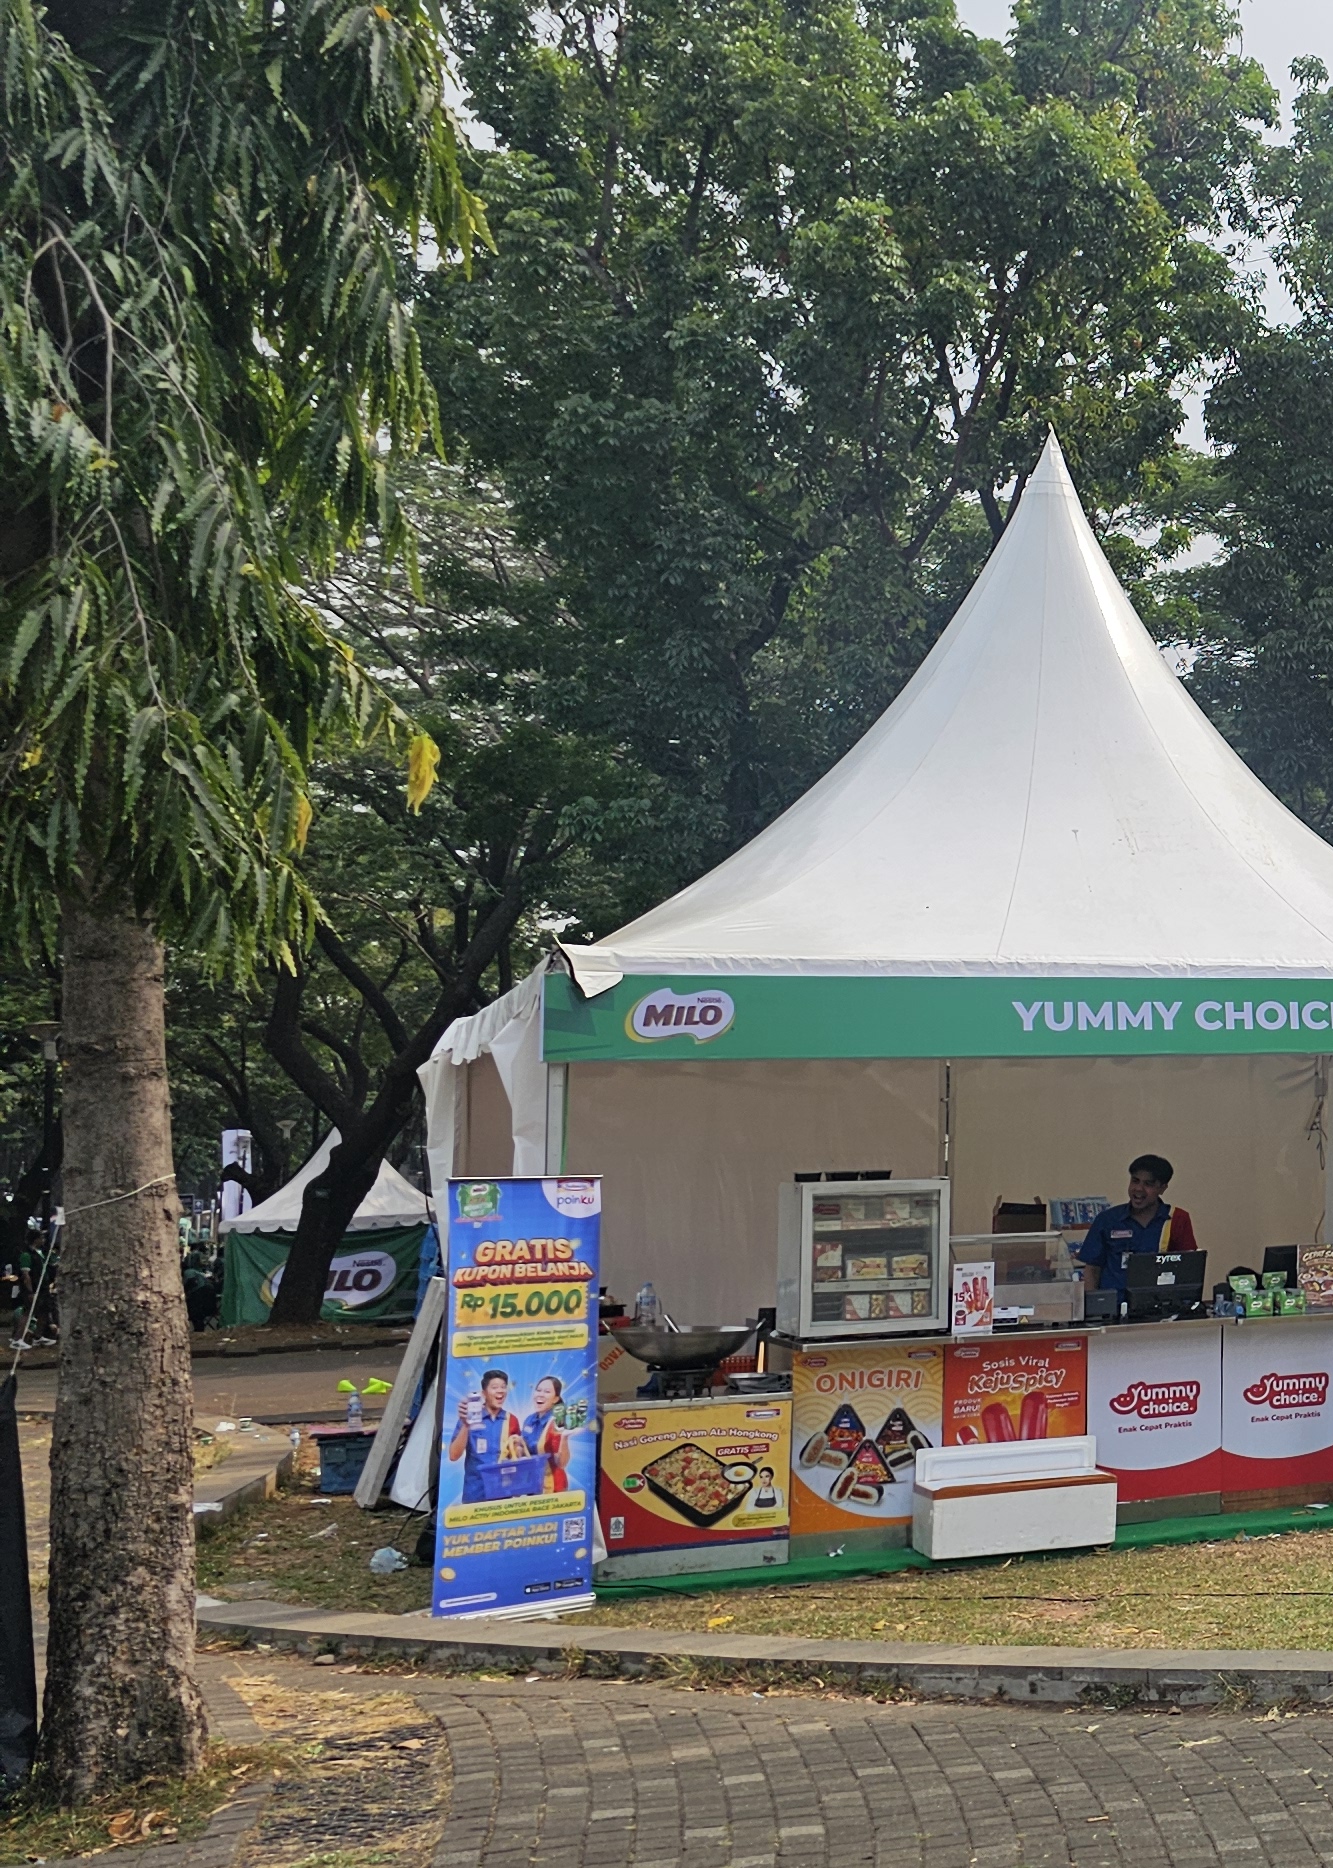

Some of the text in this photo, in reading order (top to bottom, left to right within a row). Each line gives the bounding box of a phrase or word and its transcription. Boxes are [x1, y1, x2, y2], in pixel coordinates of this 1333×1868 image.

[643, 1004, 723, 1027] MILO
[1011, 1001, 1182, 1031] YUMMY
[475, 1238, 574, 1264] GRATIS
[327, 1268, 382, 1291] ILO
[454, 1261, 594, 1284] KUPON BELANJA
[460, 1288, 583, 1320] Rp 15.000
[954, 1291, 972, 1303] 15K
[982, 1356, 1050, 1372] Sosis Viral
[815, 1369, 924, 1393] ONIGIRI
[1131, 1383, 1198, 1401] Yummy
[1264, 1374, 1327, 1391] Yummy
[1118, 1420, 1192, 1434] Enak Cepat Praktis
[1271, 1413, 1293, 1422] Cepat
[1294, 1410, 1321, 1419] Praktis
[614, 1428, 779, 1450] Nasi Goreng Ayam Ala Hongkong
[717, 1446, 749, 1456] GRATIS
[443, 1521, 559, 1546] YUK DAFTAR JADI
[442, 1533, 558, 1559] MEMBER POINKU!
